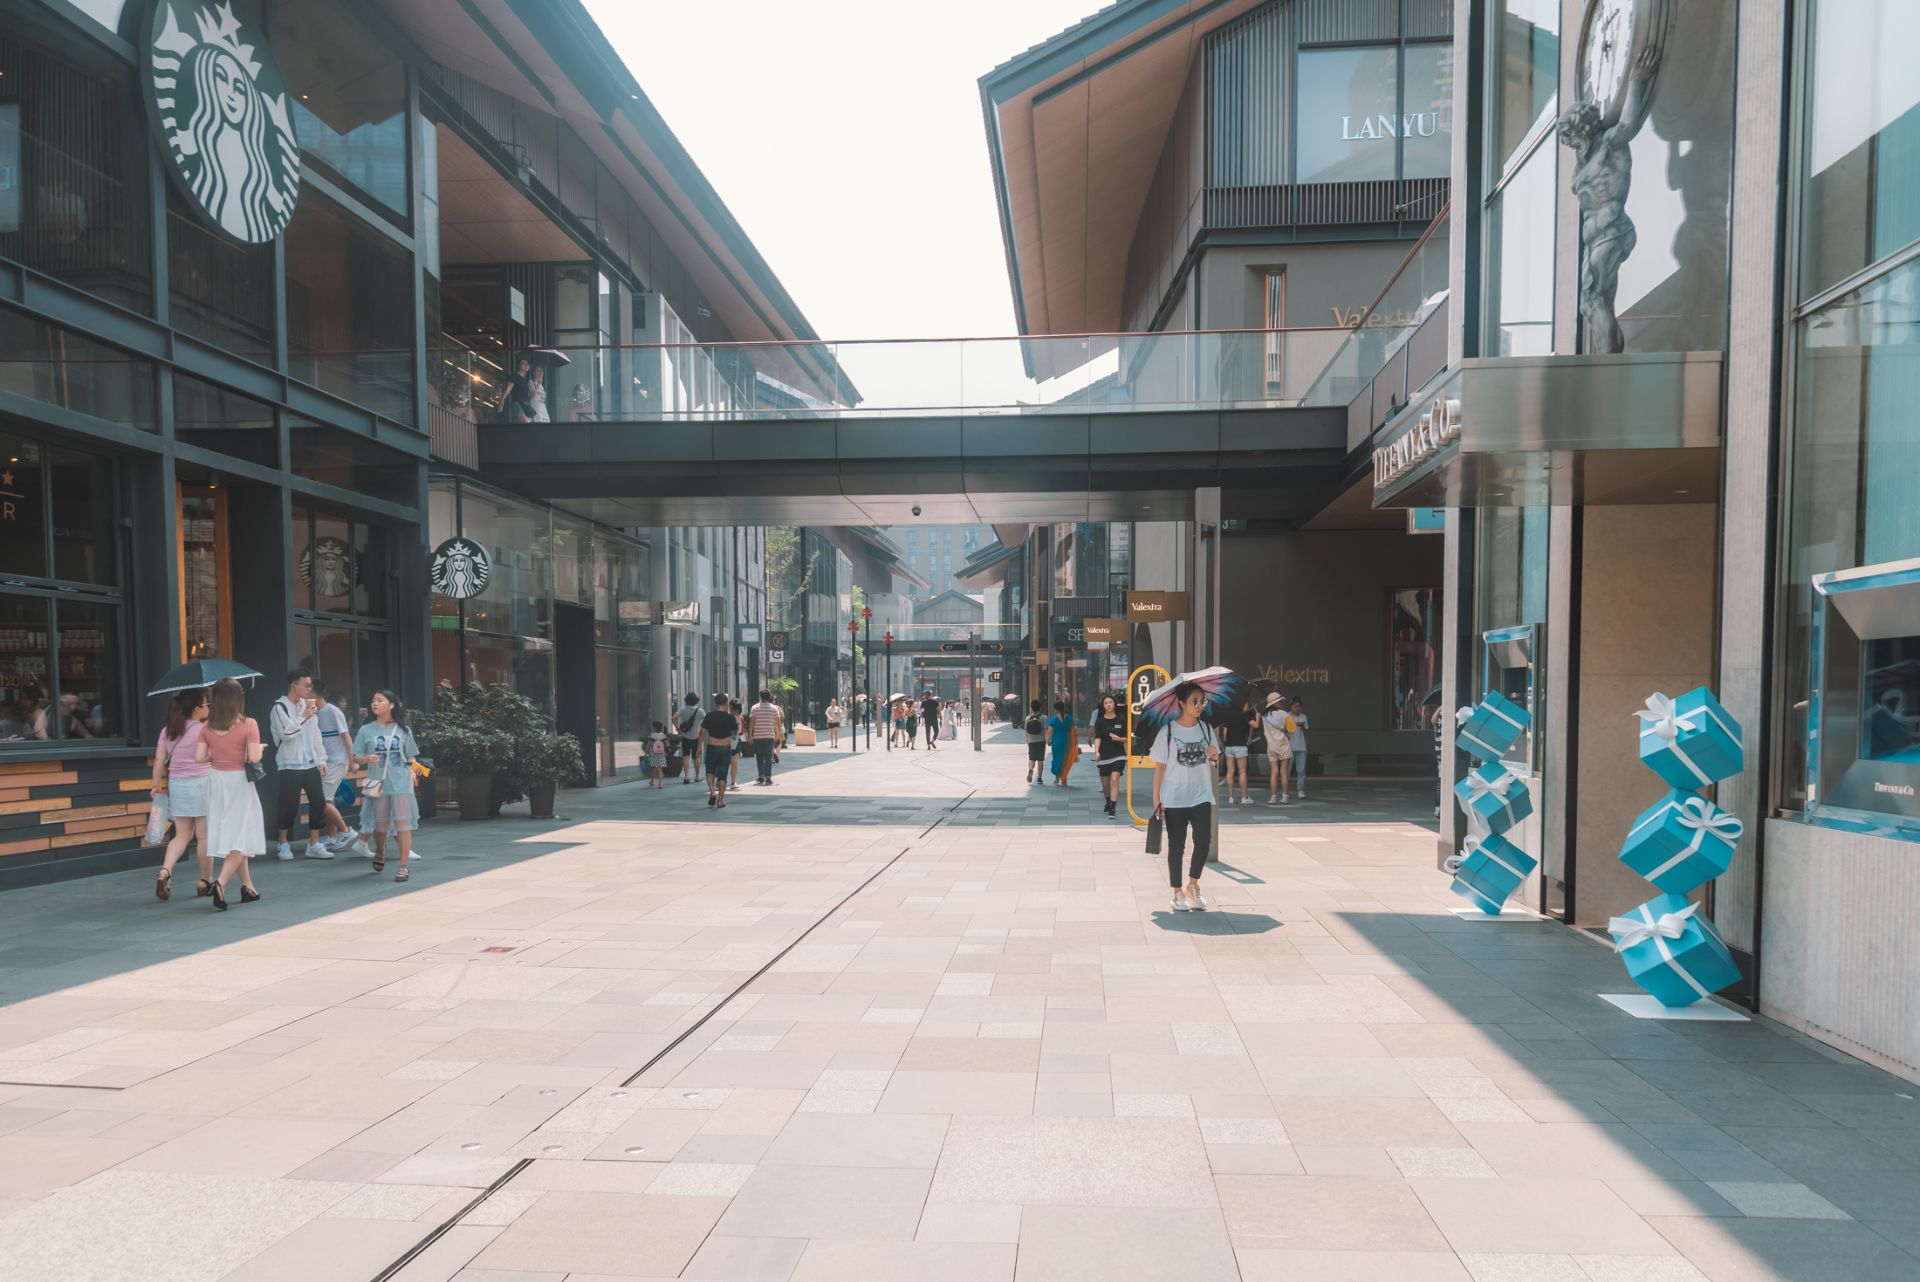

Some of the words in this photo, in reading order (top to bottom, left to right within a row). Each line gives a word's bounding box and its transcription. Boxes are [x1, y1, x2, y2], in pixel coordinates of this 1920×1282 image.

[1340, 112, 1438, 140] LANYU
[3, 502, 16, 520] R
[1131, 602, 1162, 611] Valextra
[1087, 626, 1110, 634] Valextra
[772, 650, 782, 659] G
[1257, 664, 1329, 683] Valextra
